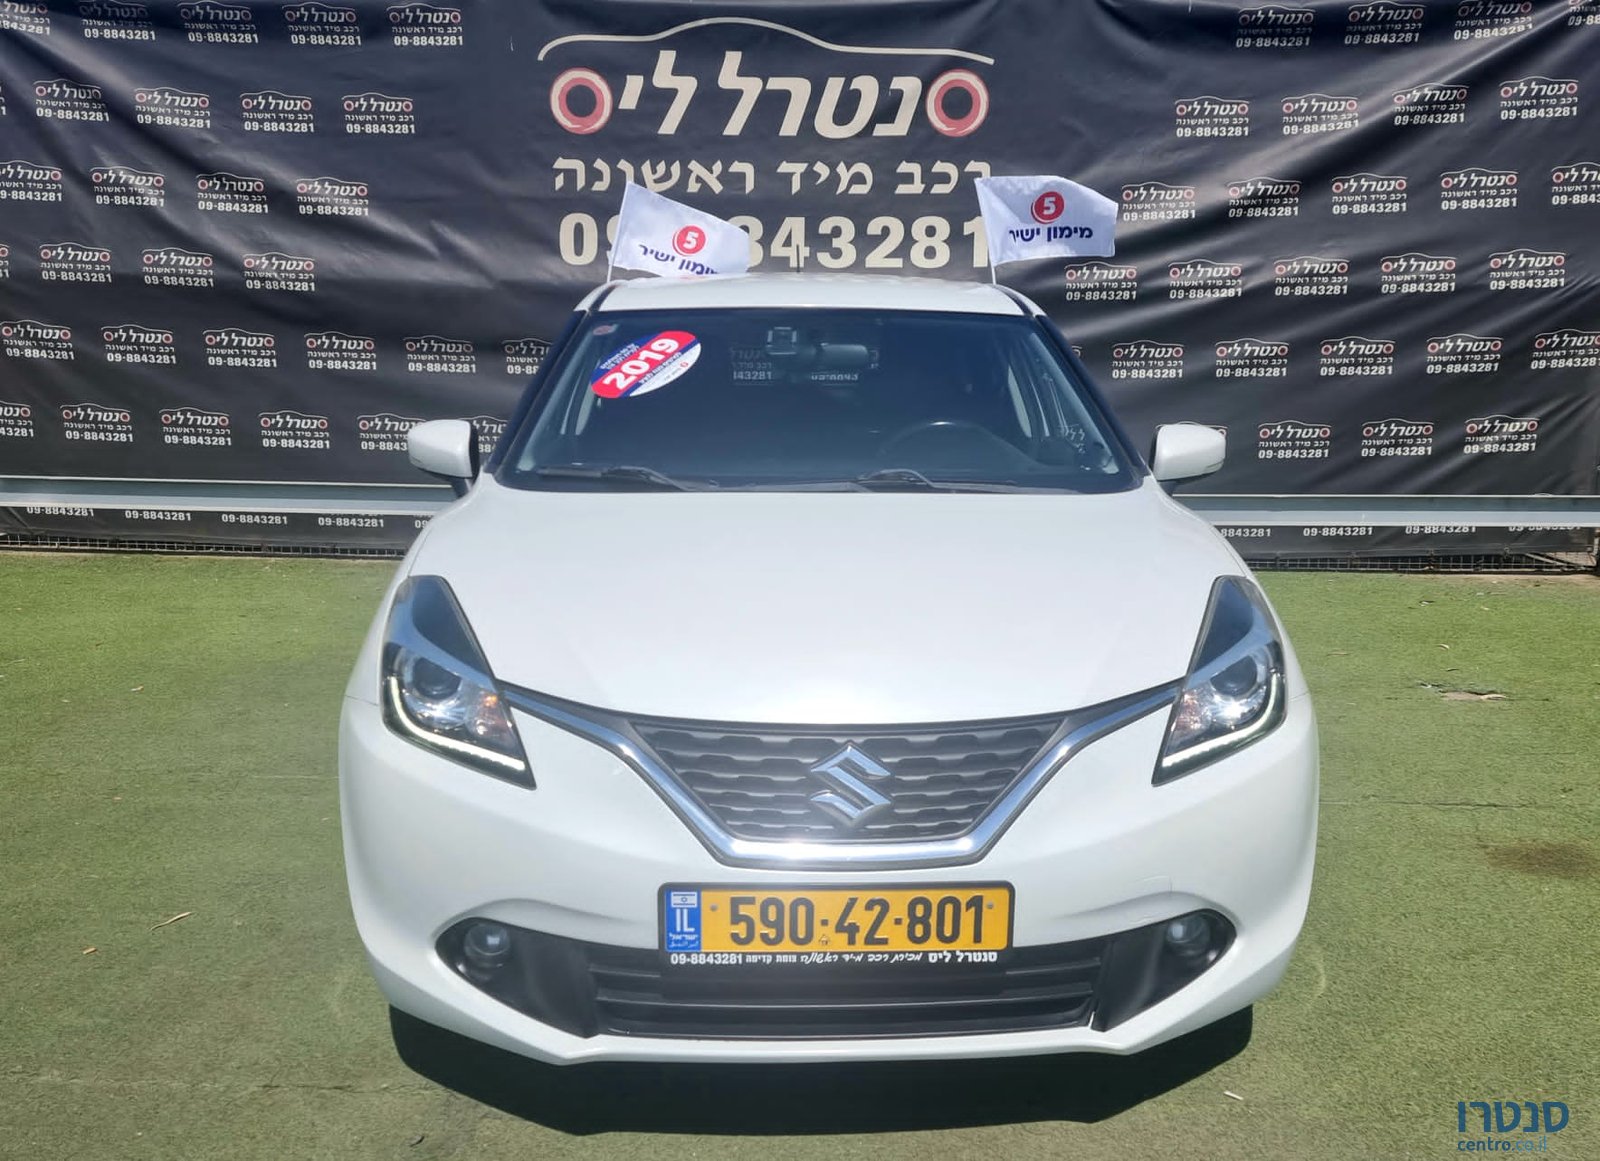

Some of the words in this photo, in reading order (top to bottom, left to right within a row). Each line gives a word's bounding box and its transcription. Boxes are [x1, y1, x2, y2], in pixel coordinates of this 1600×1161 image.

[0, 20, 50, 36] 843281
[1454, 23, 1533, 40] 09-8843281
[84, 28, 156, 40] 09-8843281
[187, 32, 259, 43] 09-8843281
[290, 34, 361, 45] 09-8843281
[1344, 33, 1420, 45] 09-8843281
[393, 36, 463, 46] 09-8843281
[1236, 37, 1310, 48] 09-8843281
[37, 108, 109, 122] 09-8843281
[1393, 113, 1464, 125] 09-8843281
[1499, 107, 1577, 120] 09-8843281
[136, 114, 210, 128] 09-8843281
[244, 121, 314, 132] 09-8843281
[346, 124, 415, 134] 09-8843281
[1176, 127, 1248, 137] 09-8843281
[1282, 122, 1358, 134] 09-8843281
[552, 157, 755, 195] ראשונה
[776, 160, 873, 195] מיד
[94, 194, 164, 207] 09-8843281
[1440, 198, 1516, 210] 09-8843281
[200, 201, 267, 213] 09-8843281
[298, 205, 368, 216] 09-8843281
[1227, 206, 1298, 218] 09-8843281
[1332, 202, 1406, 214] 09-8843281
[1123, 211, 1194, 220] 09-8843281
[1009, 228, 1041, 243] ישיר
[1047, 225, 1093, 242] מימון
[639, 244, 676, 262] ישיר
[41, 271, 111, 282] 09-8843281
[144, 275, 213, 287] 09-8843281
[245, 280, 315, 291] 09-8843281
[1381, 282, 1455, 293] 09-8843281
[1489, 278, 1564, 290] 09-8843281
[1066, 291, 1136, 300] 09-8843281
[1168, 289, 1239, 299] 09-8843281
[1274, 285, 1347, 296] 09-8843281
[6, 348, 74, 360] 09-8843281
[107, 353, 176, 364] 09-8843281
[208, 357, 277, 367] 09-8843281
[308, 360, 376, 370] 09-8843281
[408, 362, 476, 373] 09-8843281
[603, 338, 679, 390] 2019
[1111, 369, 1182, 378] 09-8843281
[1215, 368, 1286, 377] 09-8843281
[1319, 366, 1392, 376] 09-8843281
[1425, 363, 1499, 373] 09-8843281
[65, 431, 133, 442] 09-8843281
[164, 435, 231, 446] 09-8843281
[262, 438, 329, 449] 09-8843281
[1463, 442, 1535, 453] 09-8843281
[1257, 449, 1328, 458] 09-8843281
[1360, 446, 1431, 457] 09-8843281
[125, 510, 191, 521] 09-8843281
[221, 513, 288, 525] 09-8843281
[318, 517, 384, 528] 09-8843281
[1303, 526, 1373, 536] 09-8843281
[676, 908, 695, 932] IL
[670, 953, 742, 964] 09-8843281
[800, 952, 838, 964] ראשונה
[842, 952, 863, 962] מיד
[867, 953, 888, 962] רכב
[928, 951, 951, 963] ליס
[955, 951, 998, 962] סנטרל
